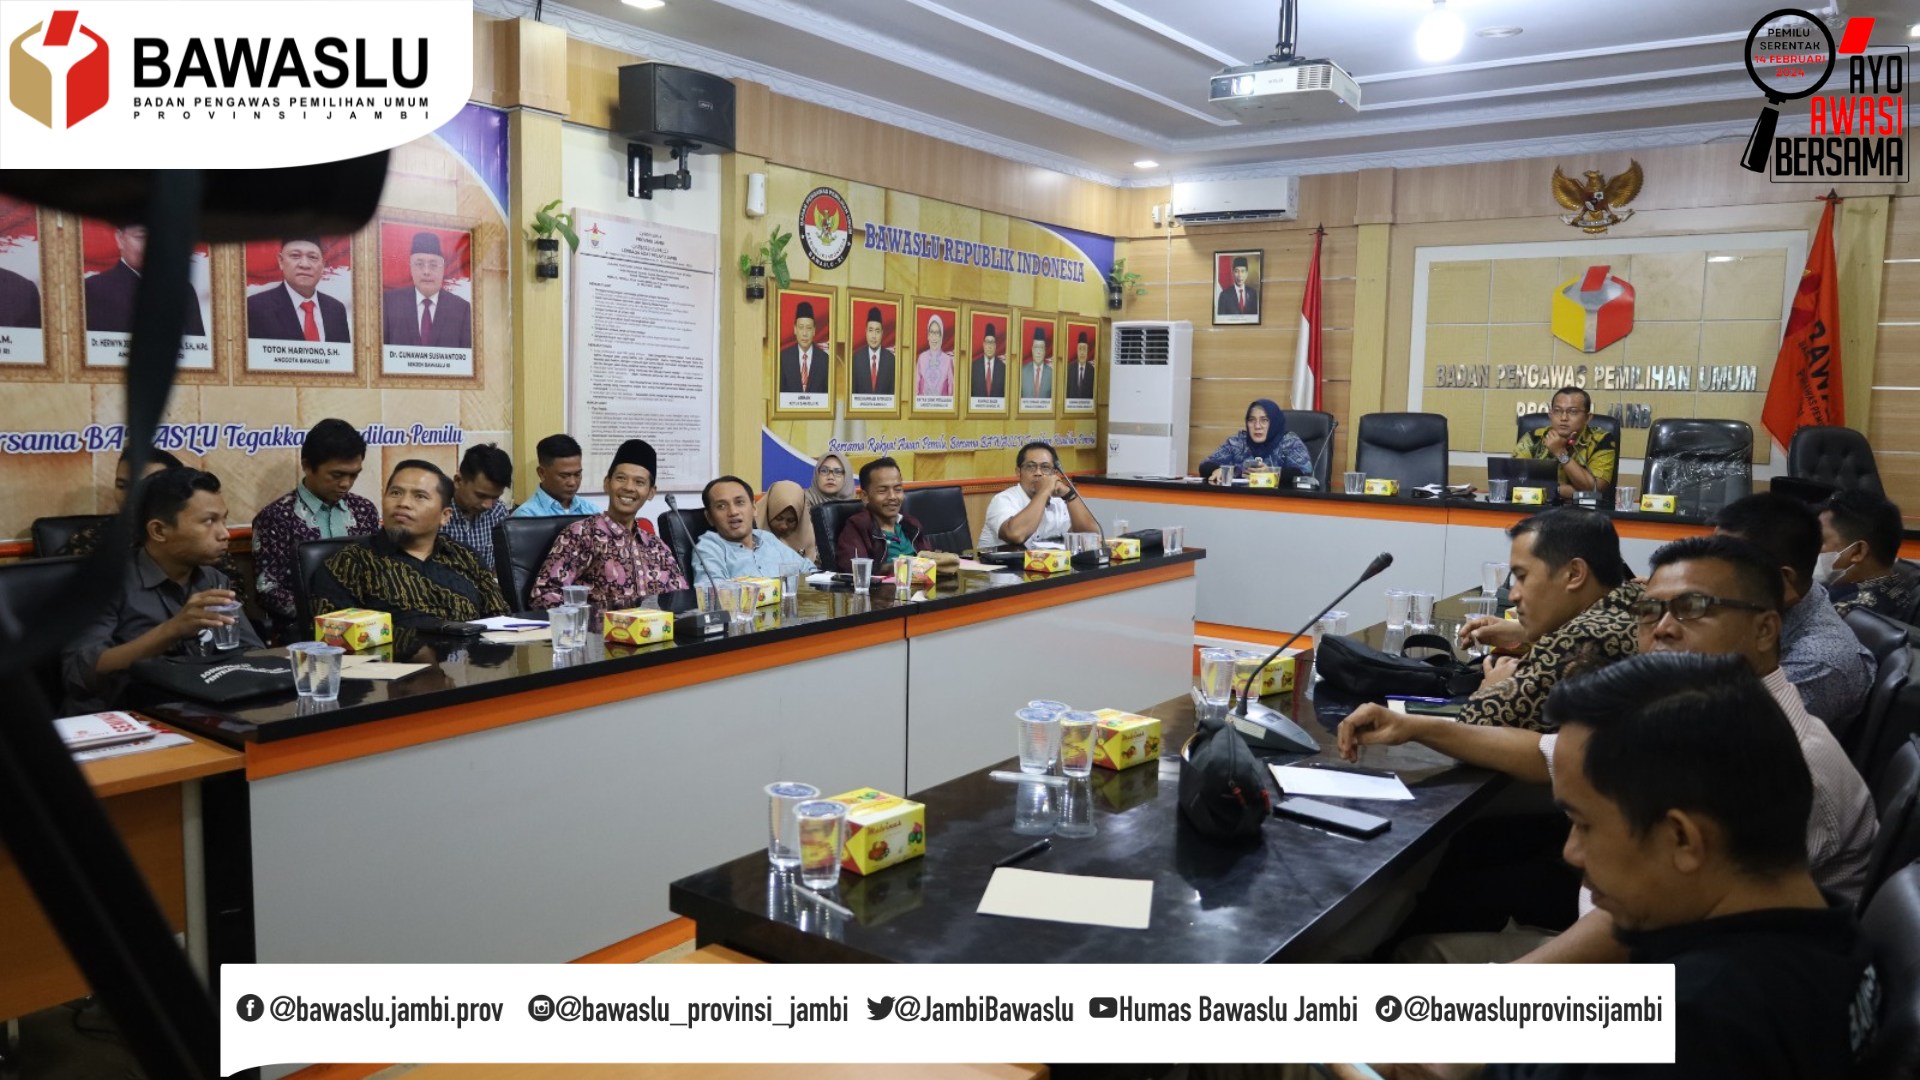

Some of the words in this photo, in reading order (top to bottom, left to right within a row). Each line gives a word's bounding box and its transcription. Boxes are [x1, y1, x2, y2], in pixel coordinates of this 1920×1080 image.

[864, 223, 940, 260] BAWASLU
[943, 238, 1015, 272] REPUBLIK
[1016, 251, 1086, 283] INDONESIA
[262, 345, 287, 354] TOTOK
[288, 346, 326, 356] HARIYONO,
[1436, 364, 1490, 388] BADAN
[1496, 364, 1588, 389] PENGAWAS
[1594, 365, 1692, 390] PEMILIHAN
[1699, 366, 1758, 391] UMUM
[0, 434, 82, 451] sama
[84, 424, 219, 454] BAASLU
[223, 425, 306, 453] Tegakka
[361, 425, 407, 445] dilan
[410, 424, 463, 445] Pemilu
